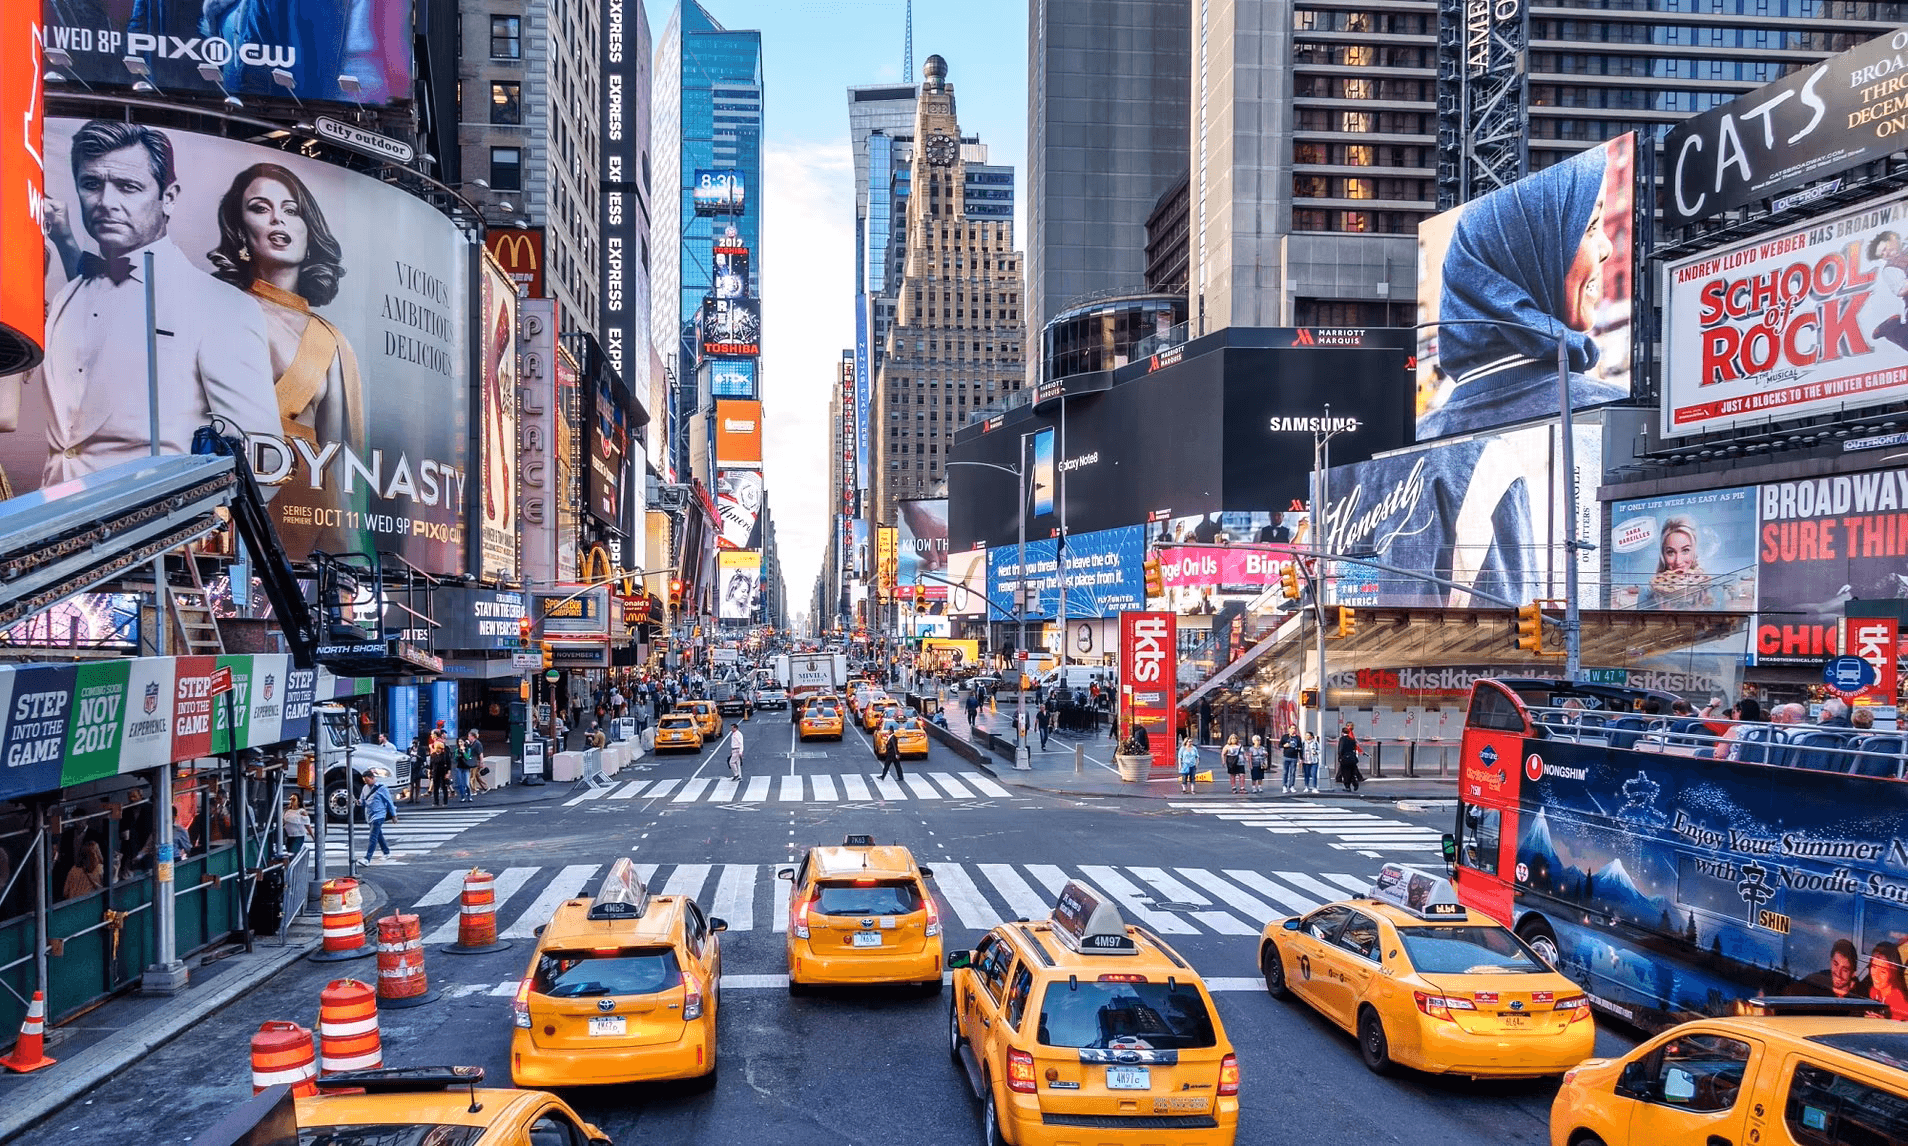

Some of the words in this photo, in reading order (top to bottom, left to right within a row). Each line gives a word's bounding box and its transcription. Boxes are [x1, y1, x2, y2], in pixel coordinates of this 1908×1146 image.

[53, 26, 92, 51] WED
[98, 30, 121, 54] 8P
[1850, 54, 1908, 89] BROA
[609, 75, 622, 140] EXPRESS
[1876, 115, 1908, 137] ON
[325, 122, 352, 140] city
[355, 131, 406, 156] outdoor
[1674, 64, 1830, 218] CATS
[609, 156, 622, 225] EXPESS
[1724, 248, 1757, 271] LLOYD
[1760, 232, 1806, 260] WEBBER
[1809, 226, 1833, 246] HAS
[608, 238, 622, 311] EXPRESS
[1700, 240, 1879, 328] SCHOOL
[1764, 296, 1799, 335] of
[704, 343, 759, 354] TOSHIBA
[1700, 290, 1876, 388] ROCK
[1767, 369, 1798, 384] MUSICAL
[1721, 397, 1743, 413] JUST
[1745, 396, 1751, 409] 4
[1752, 391, 1787, 408] BLOCKS
[1789, 388, 1801, 400] TO
[1804, 385, 1821, 398] THE
[1824, 377, 1862, 395] WINTER
[1865, 369, 1907, 388] GARDEN
[523, 314, 544, 524] PALACE
[1270, 417, 1357, 431] SAMSUNG
[1846, 433, 1899, 449] OUTFRONT
[1079, 452, 1098, 467] Note8
[248, 432, 466, 515] DYNASTY
[283, 505, 313, 517] SERIES
[1619, 504, 1627, 512] IF
[1628, 502, 1647, 511] ONLY
[1648, 501, 1663, 509] LIFE
[1665, 498, 1684, 507] WERE
[1687, 497, 1697, 505] AS
[1699, 494, 1718, 503] EASY
[1720, 493, 1730, 501] AS
[282, 516, 313, 526] PREMIERE
[314, 507, 343, 528] OCT
[346, 512, 360, 529] 11
[364, 512, 393, 533] WED
[396, 517, 410, 534] 9P
[1625, 528, 1641, 537] SARA
[1762, 519, 1837, 565] SURE
[903, 538, 932, 552] KNOW
[936, 538, 949, 551] TH
[1183, 557, 1200, 576] On
[1201, 556, 1217, 576] Us
[475, 601, 492, 616] STAY
[493, 602, 500, 617] IN
[1340, 597, 1378, 606] AMERICA
[480, 620, 495, 635] NEW
[316, 645, 350, 655] NORTH
[353, 644, 386, 654] SHORE
[1135, 617, 1168, 682] tkts
[288, 671, 313, 689] STEP
[1592, 671, 1601, 681] W
[1604, 670, 1615, 681] 47
[81, 686, 106, 698] COMING
[178, 677, 211, 699] STEP
[287, 691, 300, 702] INTO
[301, 690, 312, 700] THE
[1837, 685, 1869, 697] STANDING
[15, 691, 68, 721] STEP
[77, 694, 121, 727] NOV
[177, 701, 196, 714] INTO
[196, 700, 210, 712] THE
[254, 704, 279, 719] EXPERIENCE
[285, 703, 310, 720] GAME
[11, 723, 41, 741] INTO
[41, 719, 64, 736] THE
[128, 718, 167, 738] EXPERIENCE
[176, 714, 209, 736] GAME
[72, 722, 118, 755] 2017
[8, 738, 62, 768] GAME
[1673, 809, 1726, 850] Enjoy
[1728, 828, 1777, 854] Your
[1780, 833, 1883, 860] Summer
[1695, 857, 1736, 881] with
[1776, 866, 1858, 893] Noodle
[1759, 910, 1790, 934] SHIN
[1094, 936, 1121, 947] 4M97
